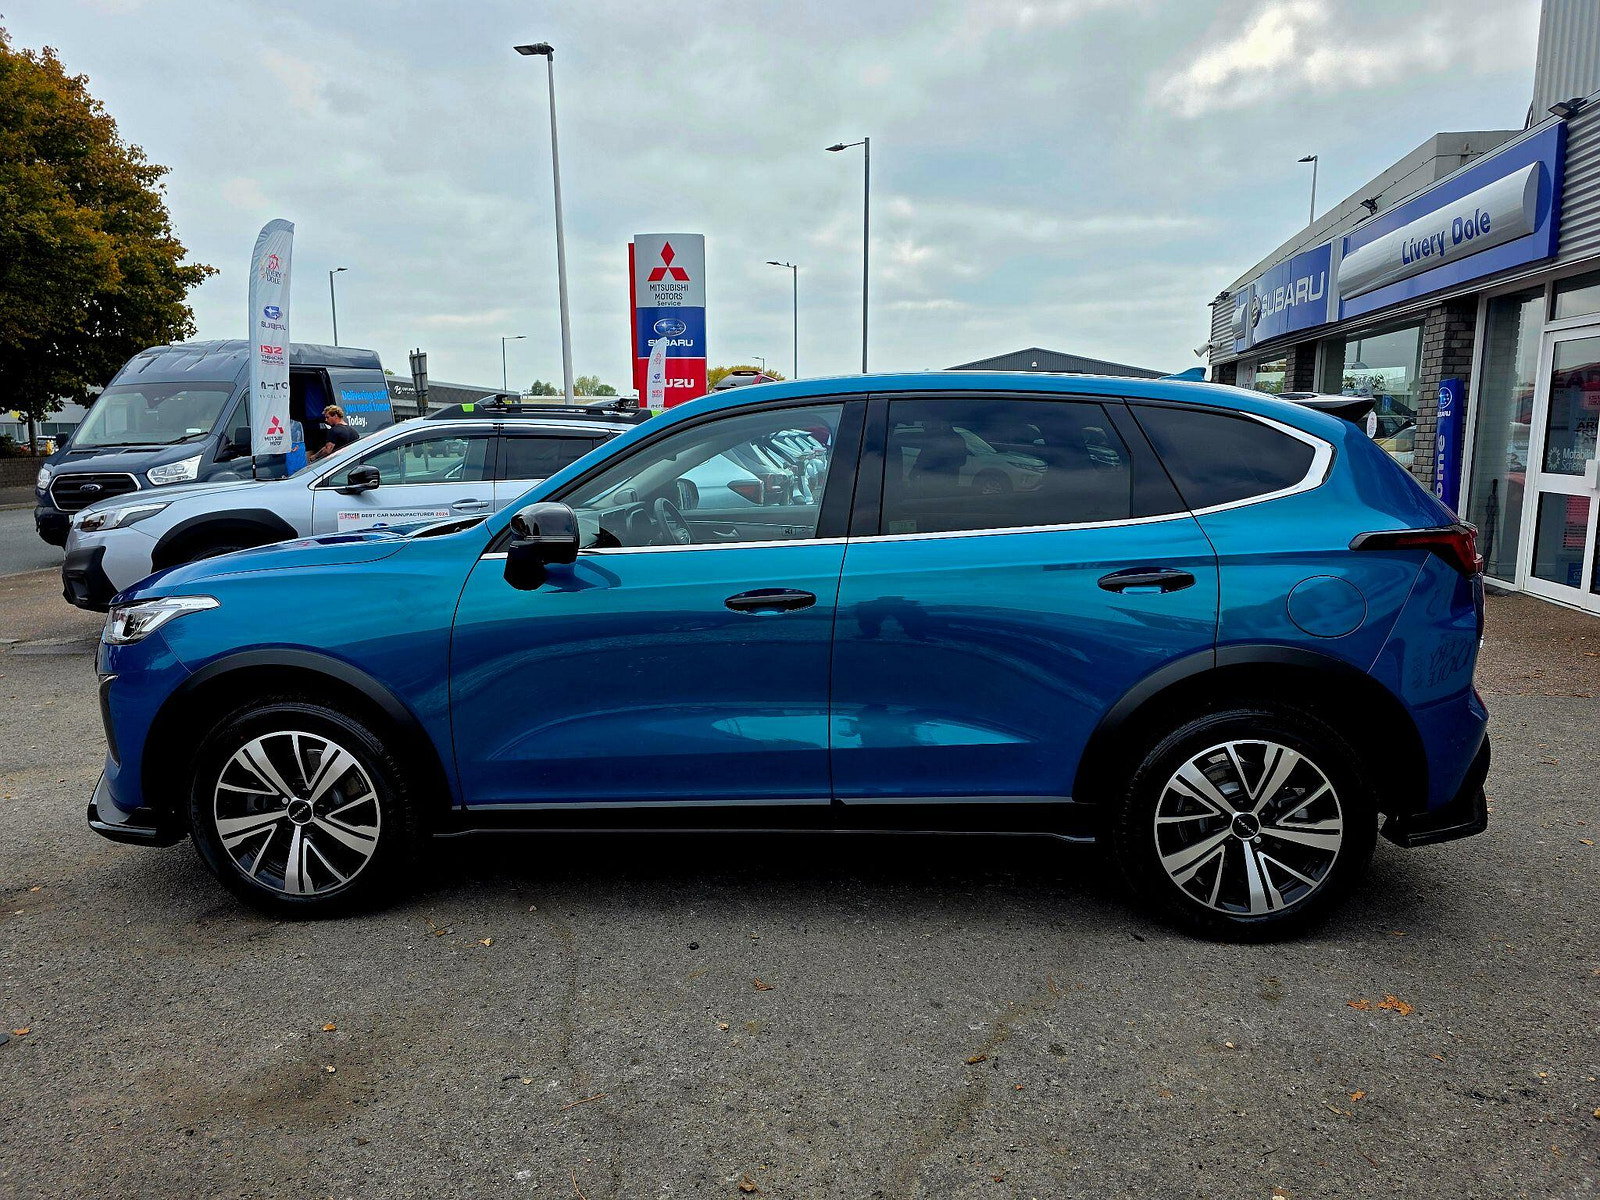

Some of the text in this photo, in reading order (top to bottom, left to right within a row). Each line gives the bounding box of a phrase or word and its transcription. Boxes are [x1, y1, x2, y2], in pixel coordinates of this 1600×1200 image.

[1401, 208, 1492, 266] Livery Dole
[649, 284, 689, 292] MITSUBISHI
[1261, 272, 1326, 319] SUBARU
[647, 339, 694, 347] SBARU
[664, 378, 695, 388] UZU
